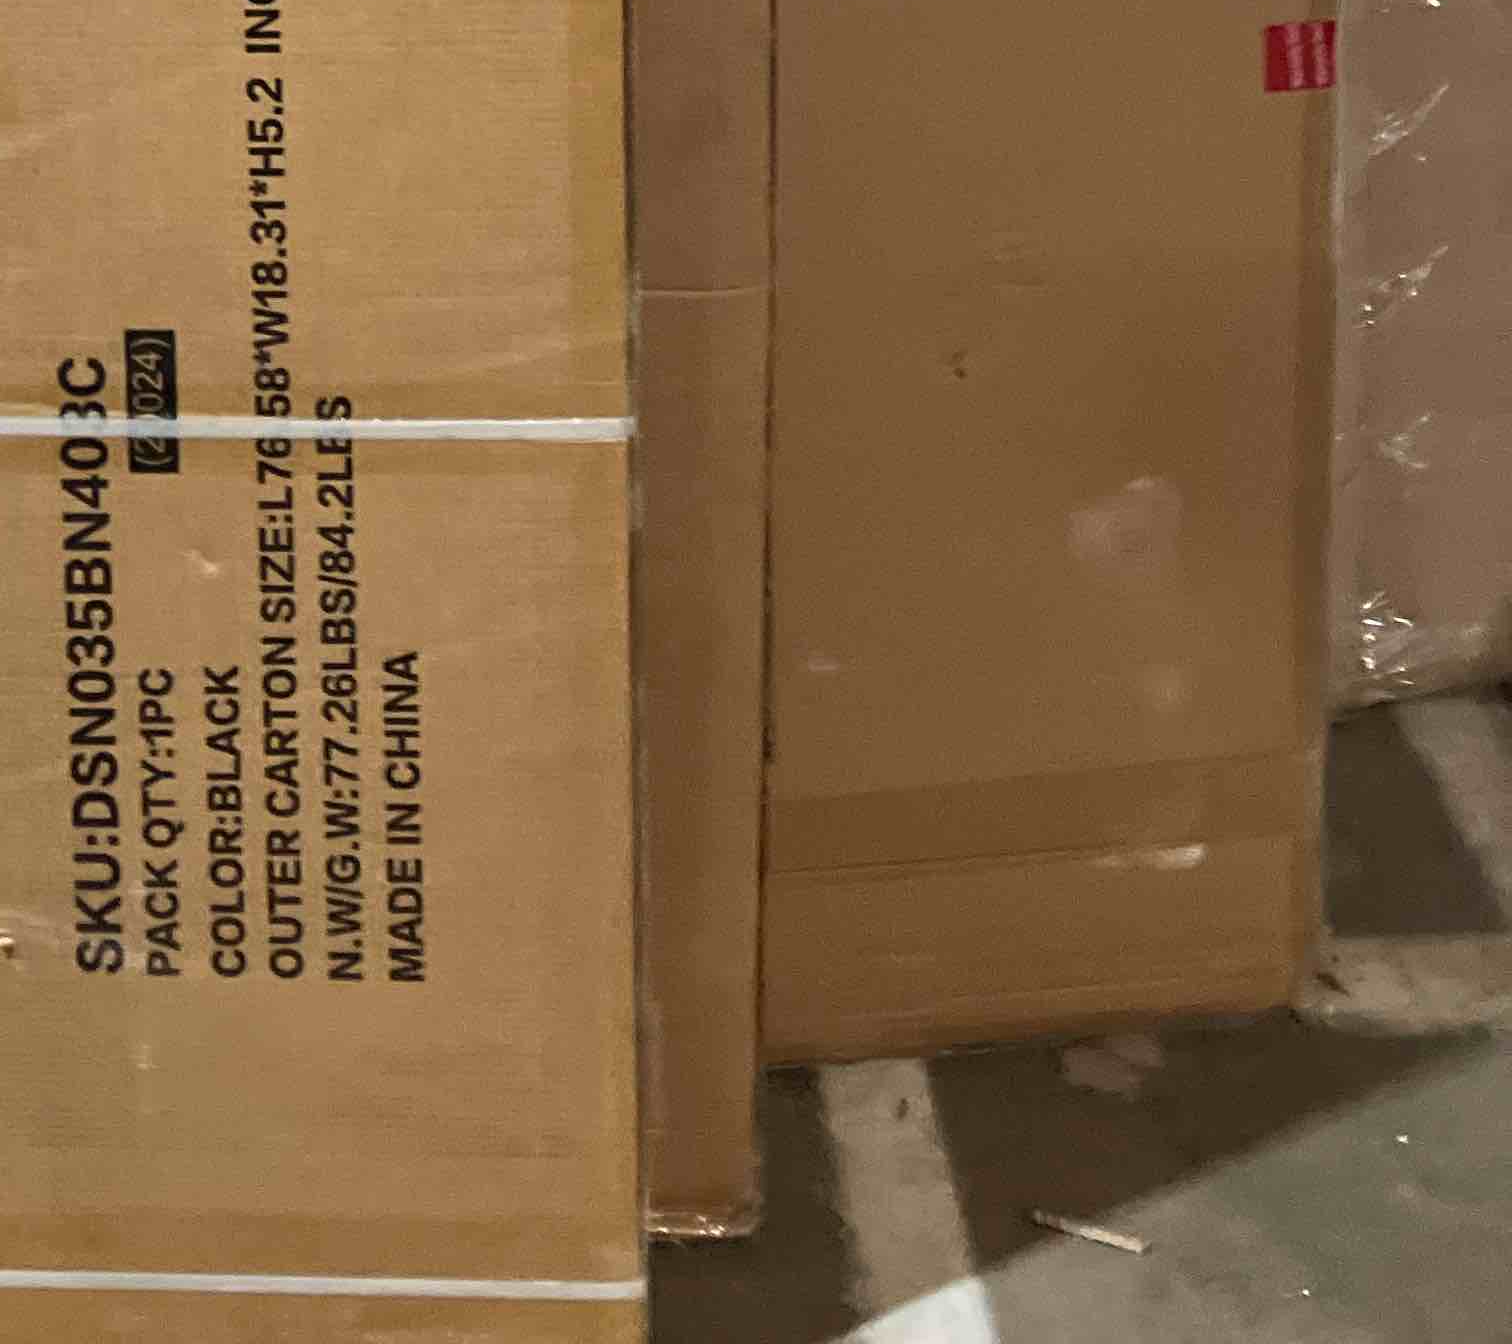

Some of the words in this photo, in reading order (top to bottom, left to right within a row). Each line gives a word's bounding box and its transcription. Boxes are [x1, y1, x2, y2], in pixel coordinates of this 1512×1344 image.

[246, 77, 298, 624] SIZE:L7658W18.31H5.2
[136, 667, 186, 850] QTY:1PC
[259, 635, 302, 819] CARTON
[380, 650, 422, 791] CHINA
[202, 664, 248, 979] COLOR:BLACK
[385, 802, 422, 846] IN
[142, 858, 182, 978] PACK
[265, 828, 305, 980] OUTER
[385, 857, 426, 983] MADE
